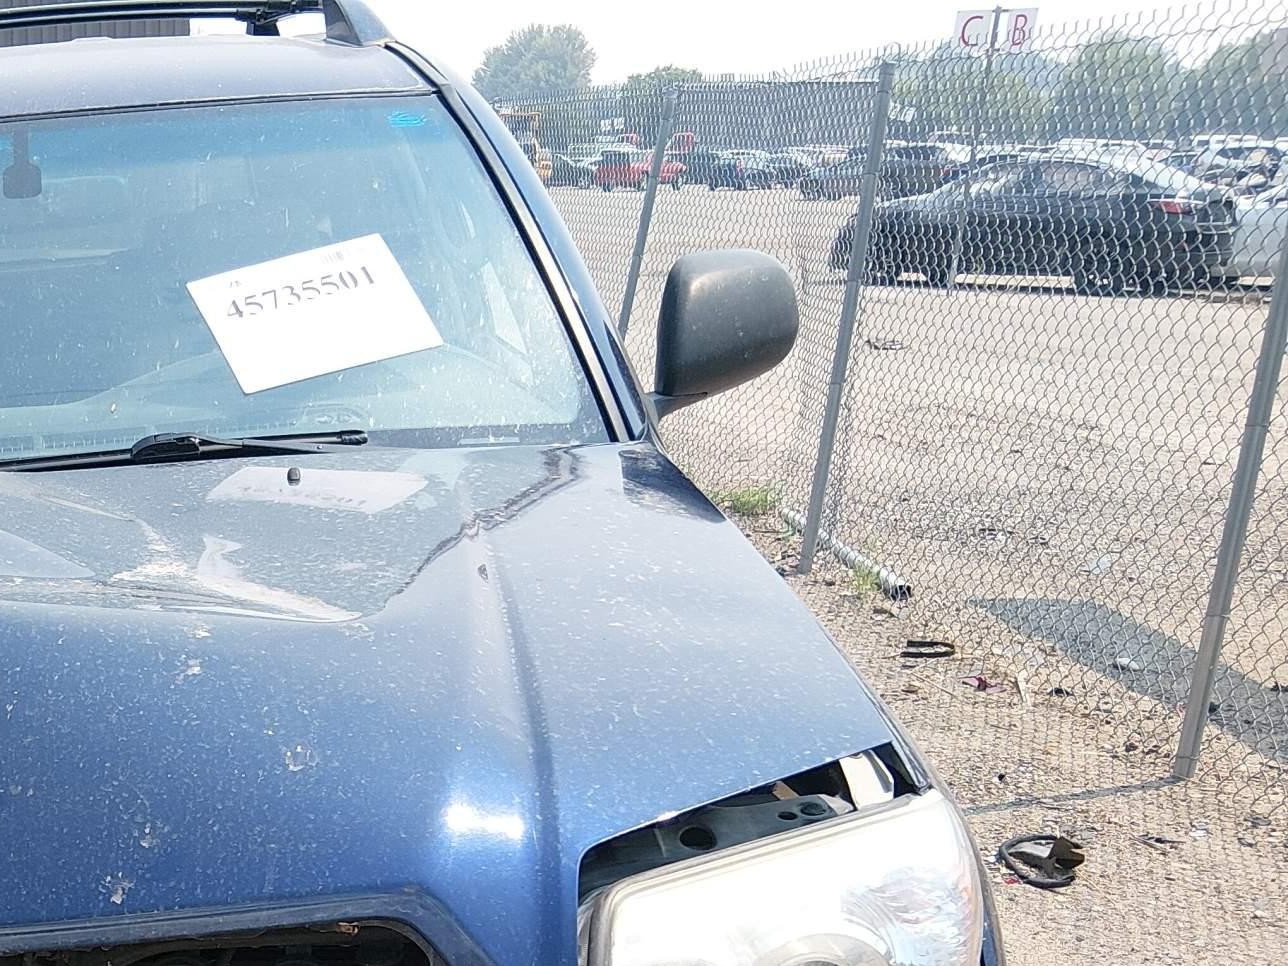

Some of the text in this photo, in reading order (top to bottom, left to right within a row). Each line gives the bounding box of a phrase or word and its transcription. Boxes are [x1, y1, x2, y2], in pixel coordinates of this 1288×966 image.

[961, 15, 984, 46] C
[1012, 14, 1028, 45] B
[226, 265, 375, 319] 45735501
